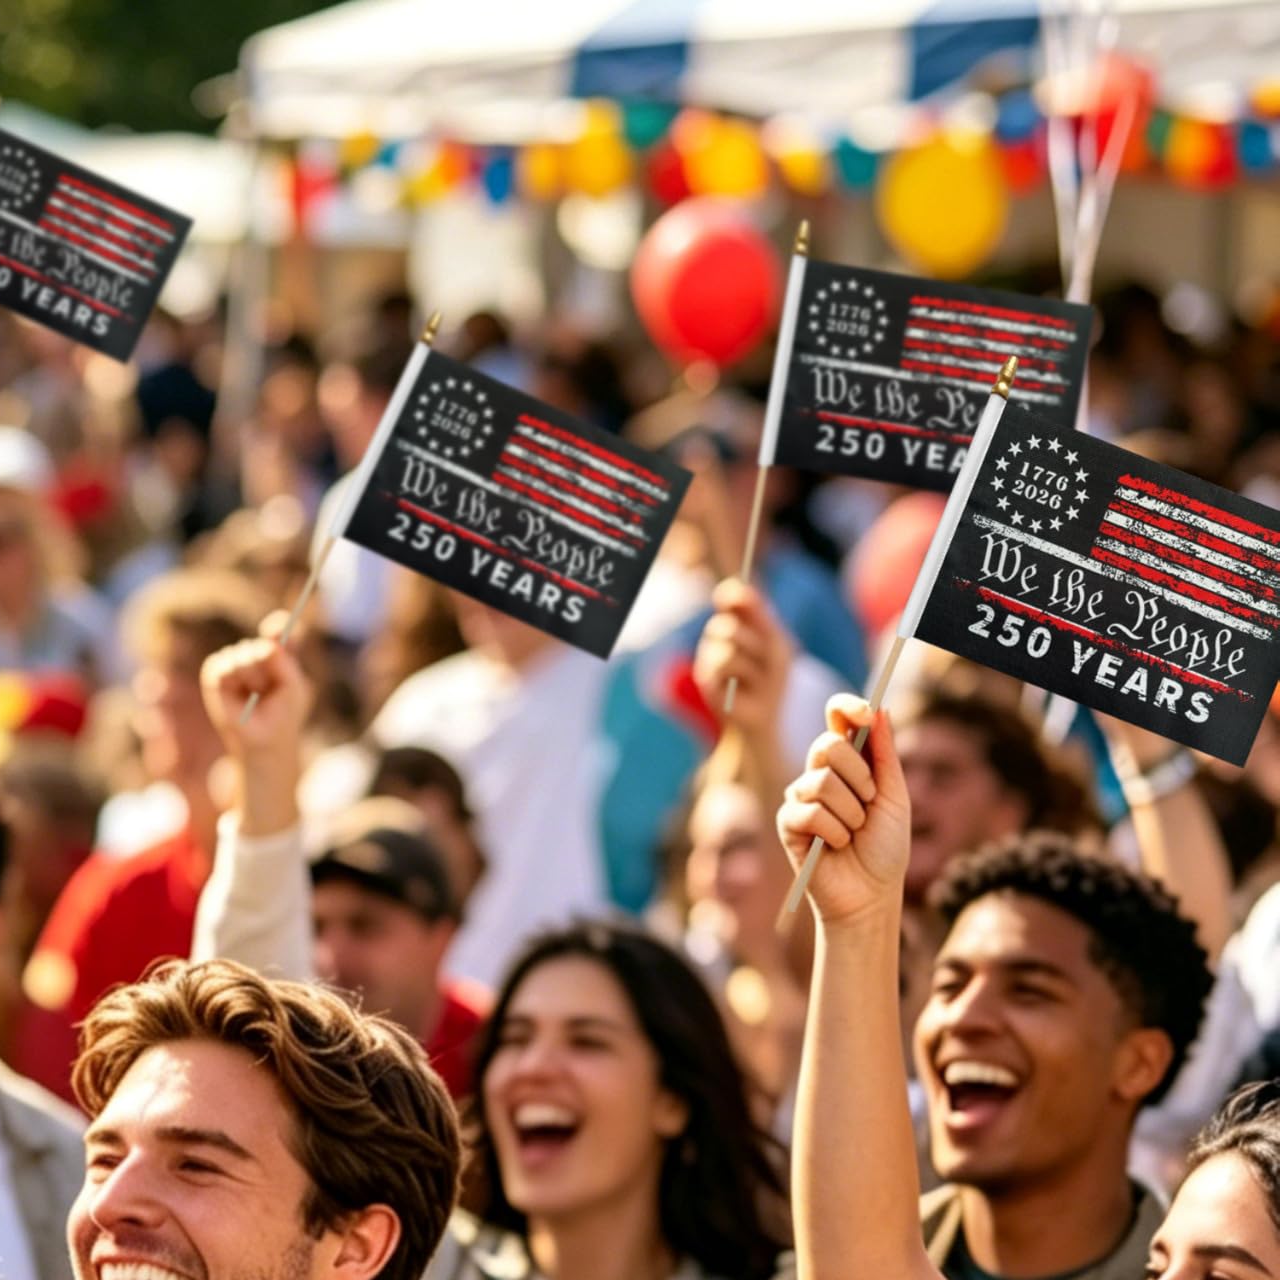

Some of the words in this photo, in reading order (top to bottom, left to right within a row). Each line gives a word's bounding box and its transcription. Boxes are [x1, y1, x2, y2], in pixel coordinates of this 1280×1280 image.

[10, 231, 47, 268] the
[20, 279, 110, 336] YEARS
[829, 302, 871, 321] 1776
[826, 319, 869, 337] 2026
[436, 398, 478, 426] 1776
[809, 367, 866, 412] We
[873, 380, 923, 422] the
[429, 414, 472, 440] 2026
[815, 425, 886, 460] 250
[1019, 461, 1070, 491] 1776
[1011, 479, 1062, 510] 2026
[401, 456, 449, 508] We
[455, 489, 501, 534] the
[501, 509, 615, 589] People
[387, 512, 457, 561] 250
[469, 548, 586, 624] YEARS
[977, 532, 1040, 596] We
[1047, 568, 1106, 622] the
[1106, 589, 1246, 680] People
[967, 603, 1052, 659] 250
[1070, 641, 1215, 724] YEARS
